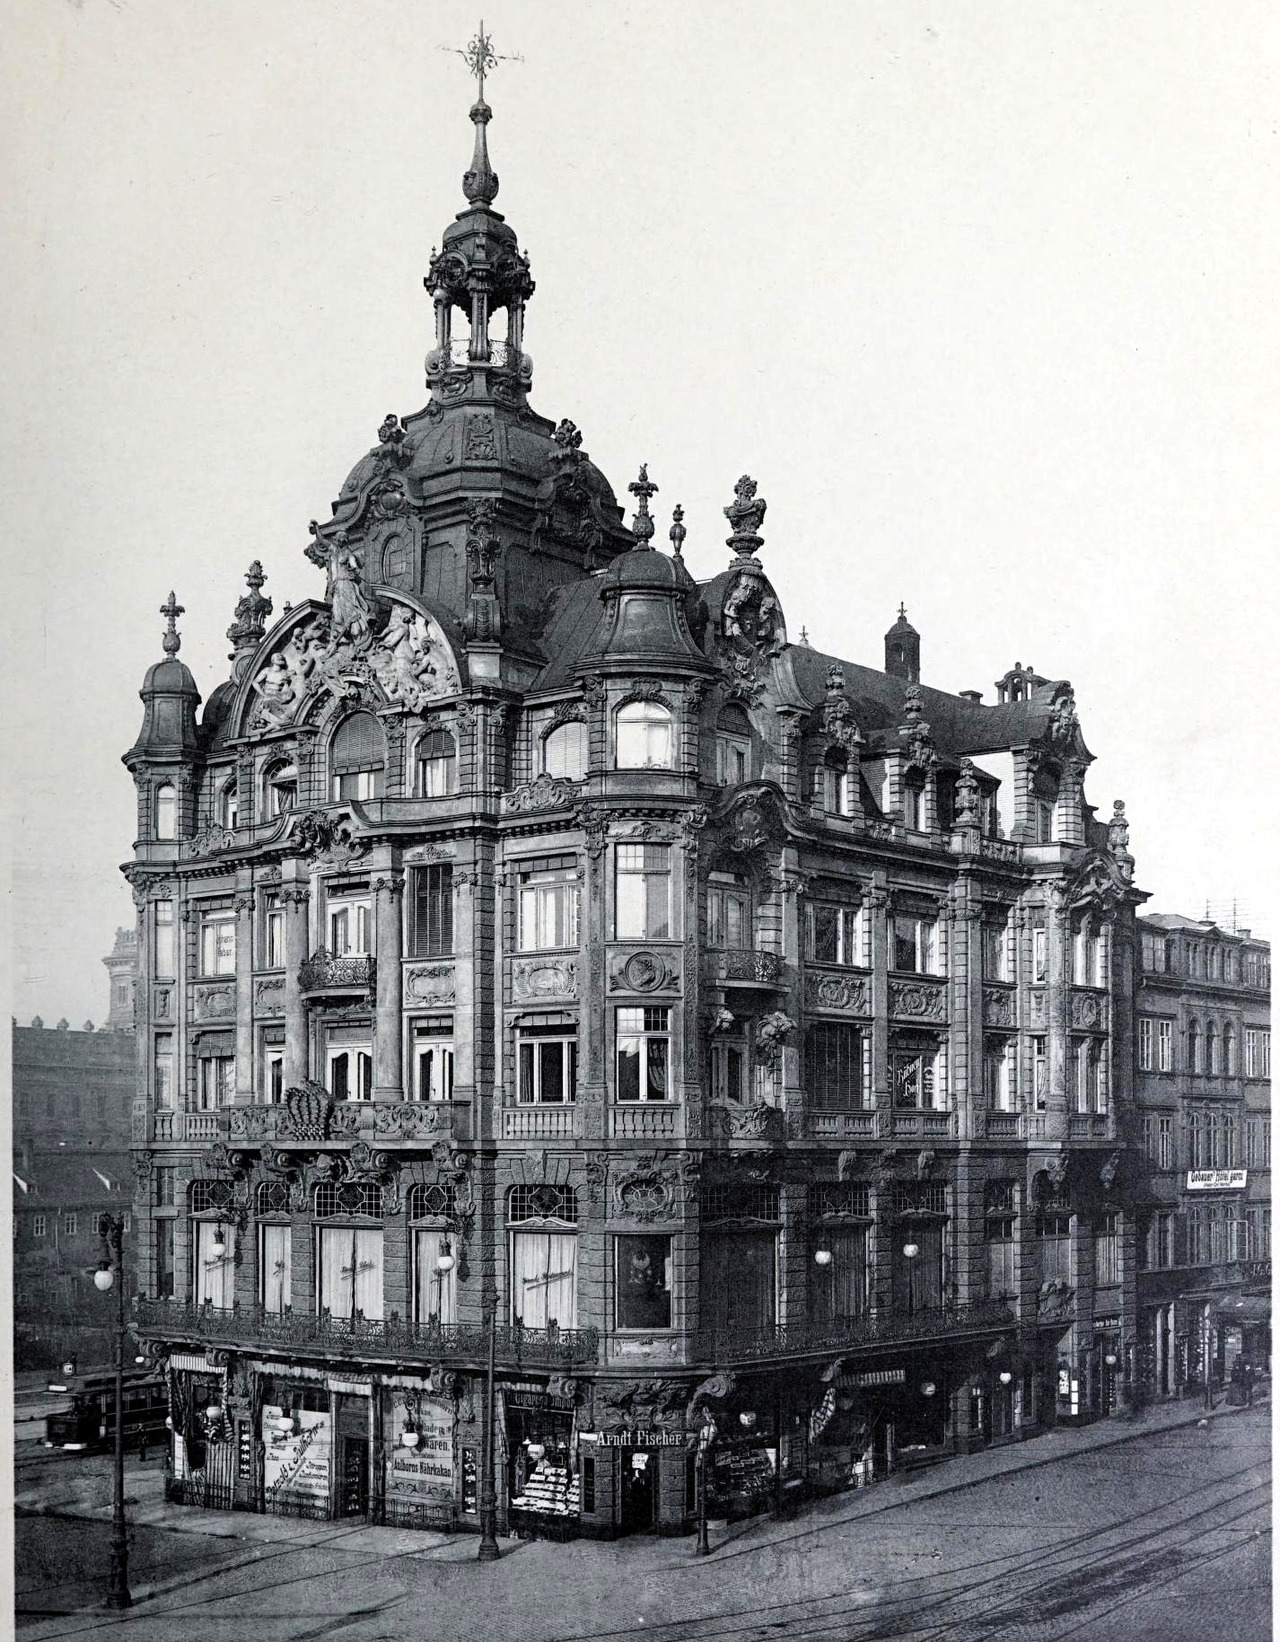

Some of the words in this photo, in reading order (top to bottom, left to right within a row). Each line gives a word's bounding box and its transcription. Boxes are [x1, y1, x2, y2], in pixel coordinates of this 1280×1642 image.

[596, 1430, 633, 1446] Arndt
[637, 1430, 682, 1446] Fischer
[419, 1461, 452, 1478] Nährkakao
